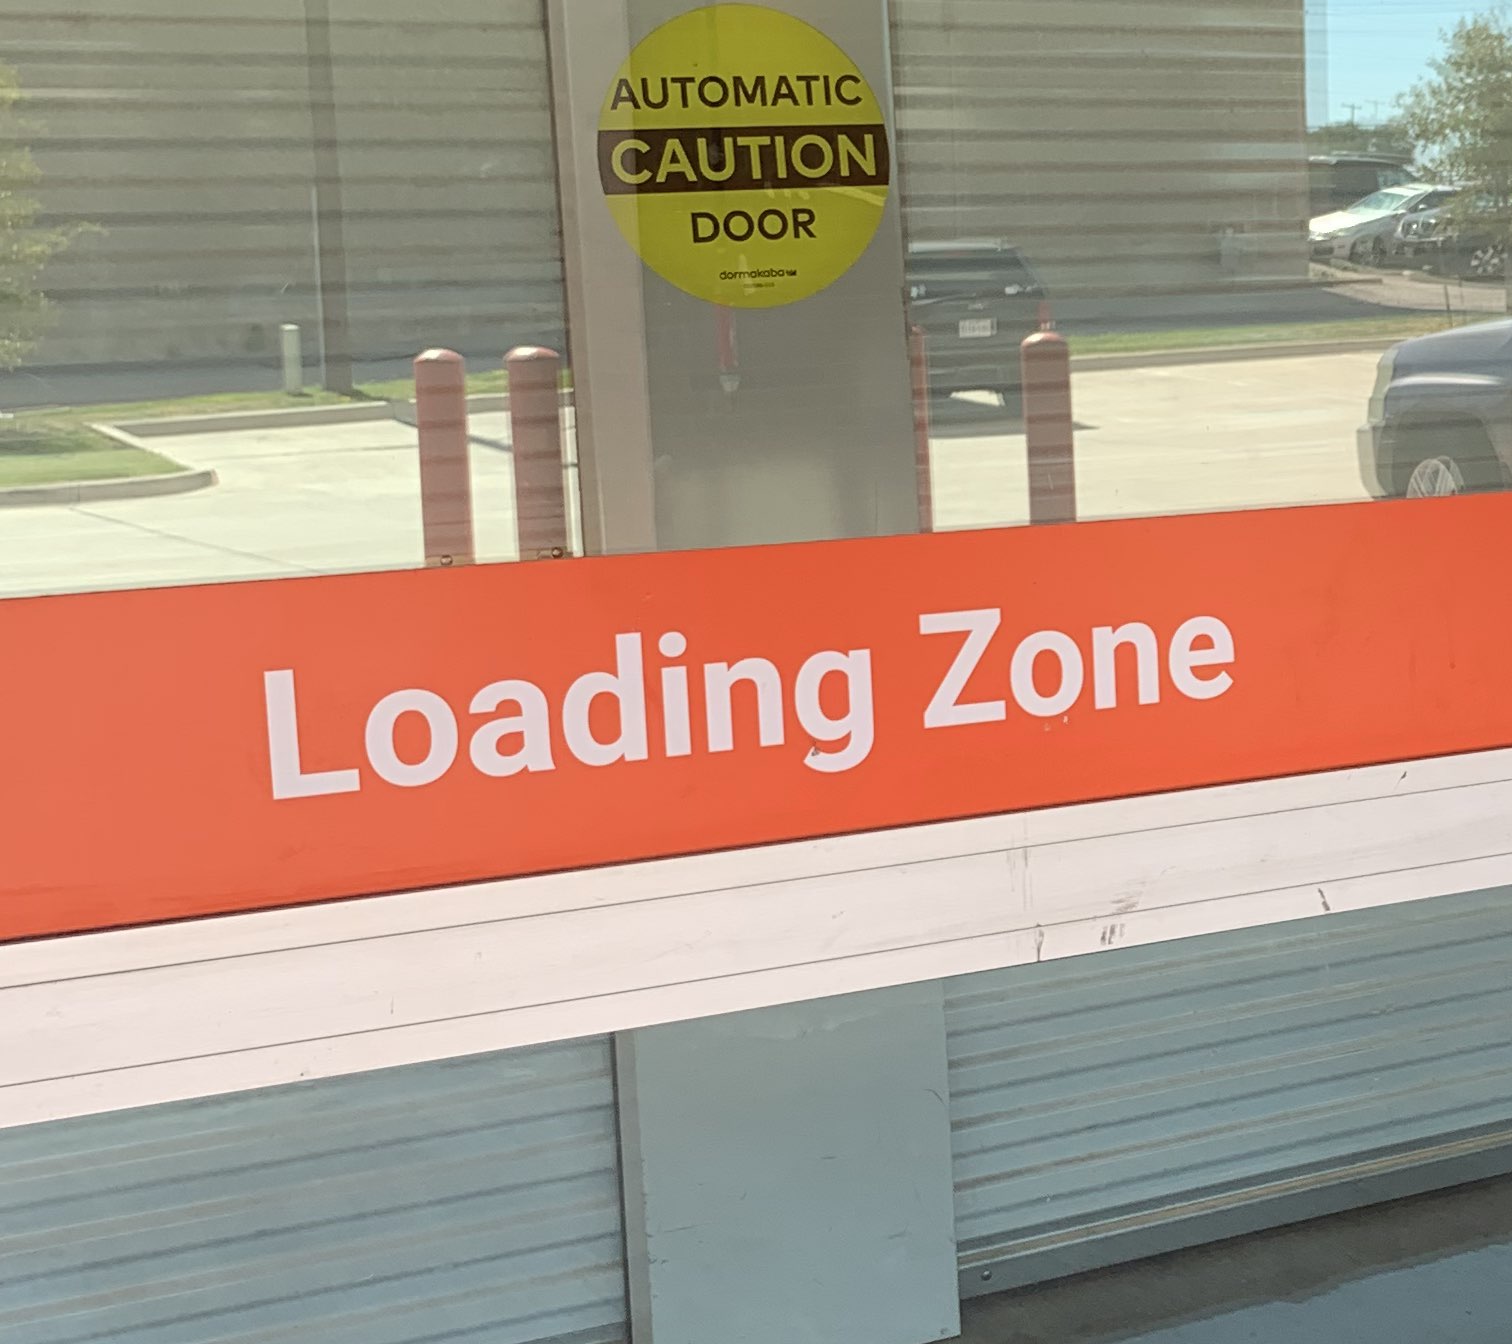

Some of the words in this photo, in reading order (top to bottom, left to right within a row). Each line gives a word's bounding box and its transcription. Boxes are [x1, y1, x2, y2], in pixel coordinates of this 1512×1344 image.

[610, 74, 864, 111] AUTOMATIC
[610, 133, 877, 185] CAUTION
[691, 208, 817, 244] DOOR
[263, 631, 874, 800] Loading
[918, 607, 1236, 728] Zone
